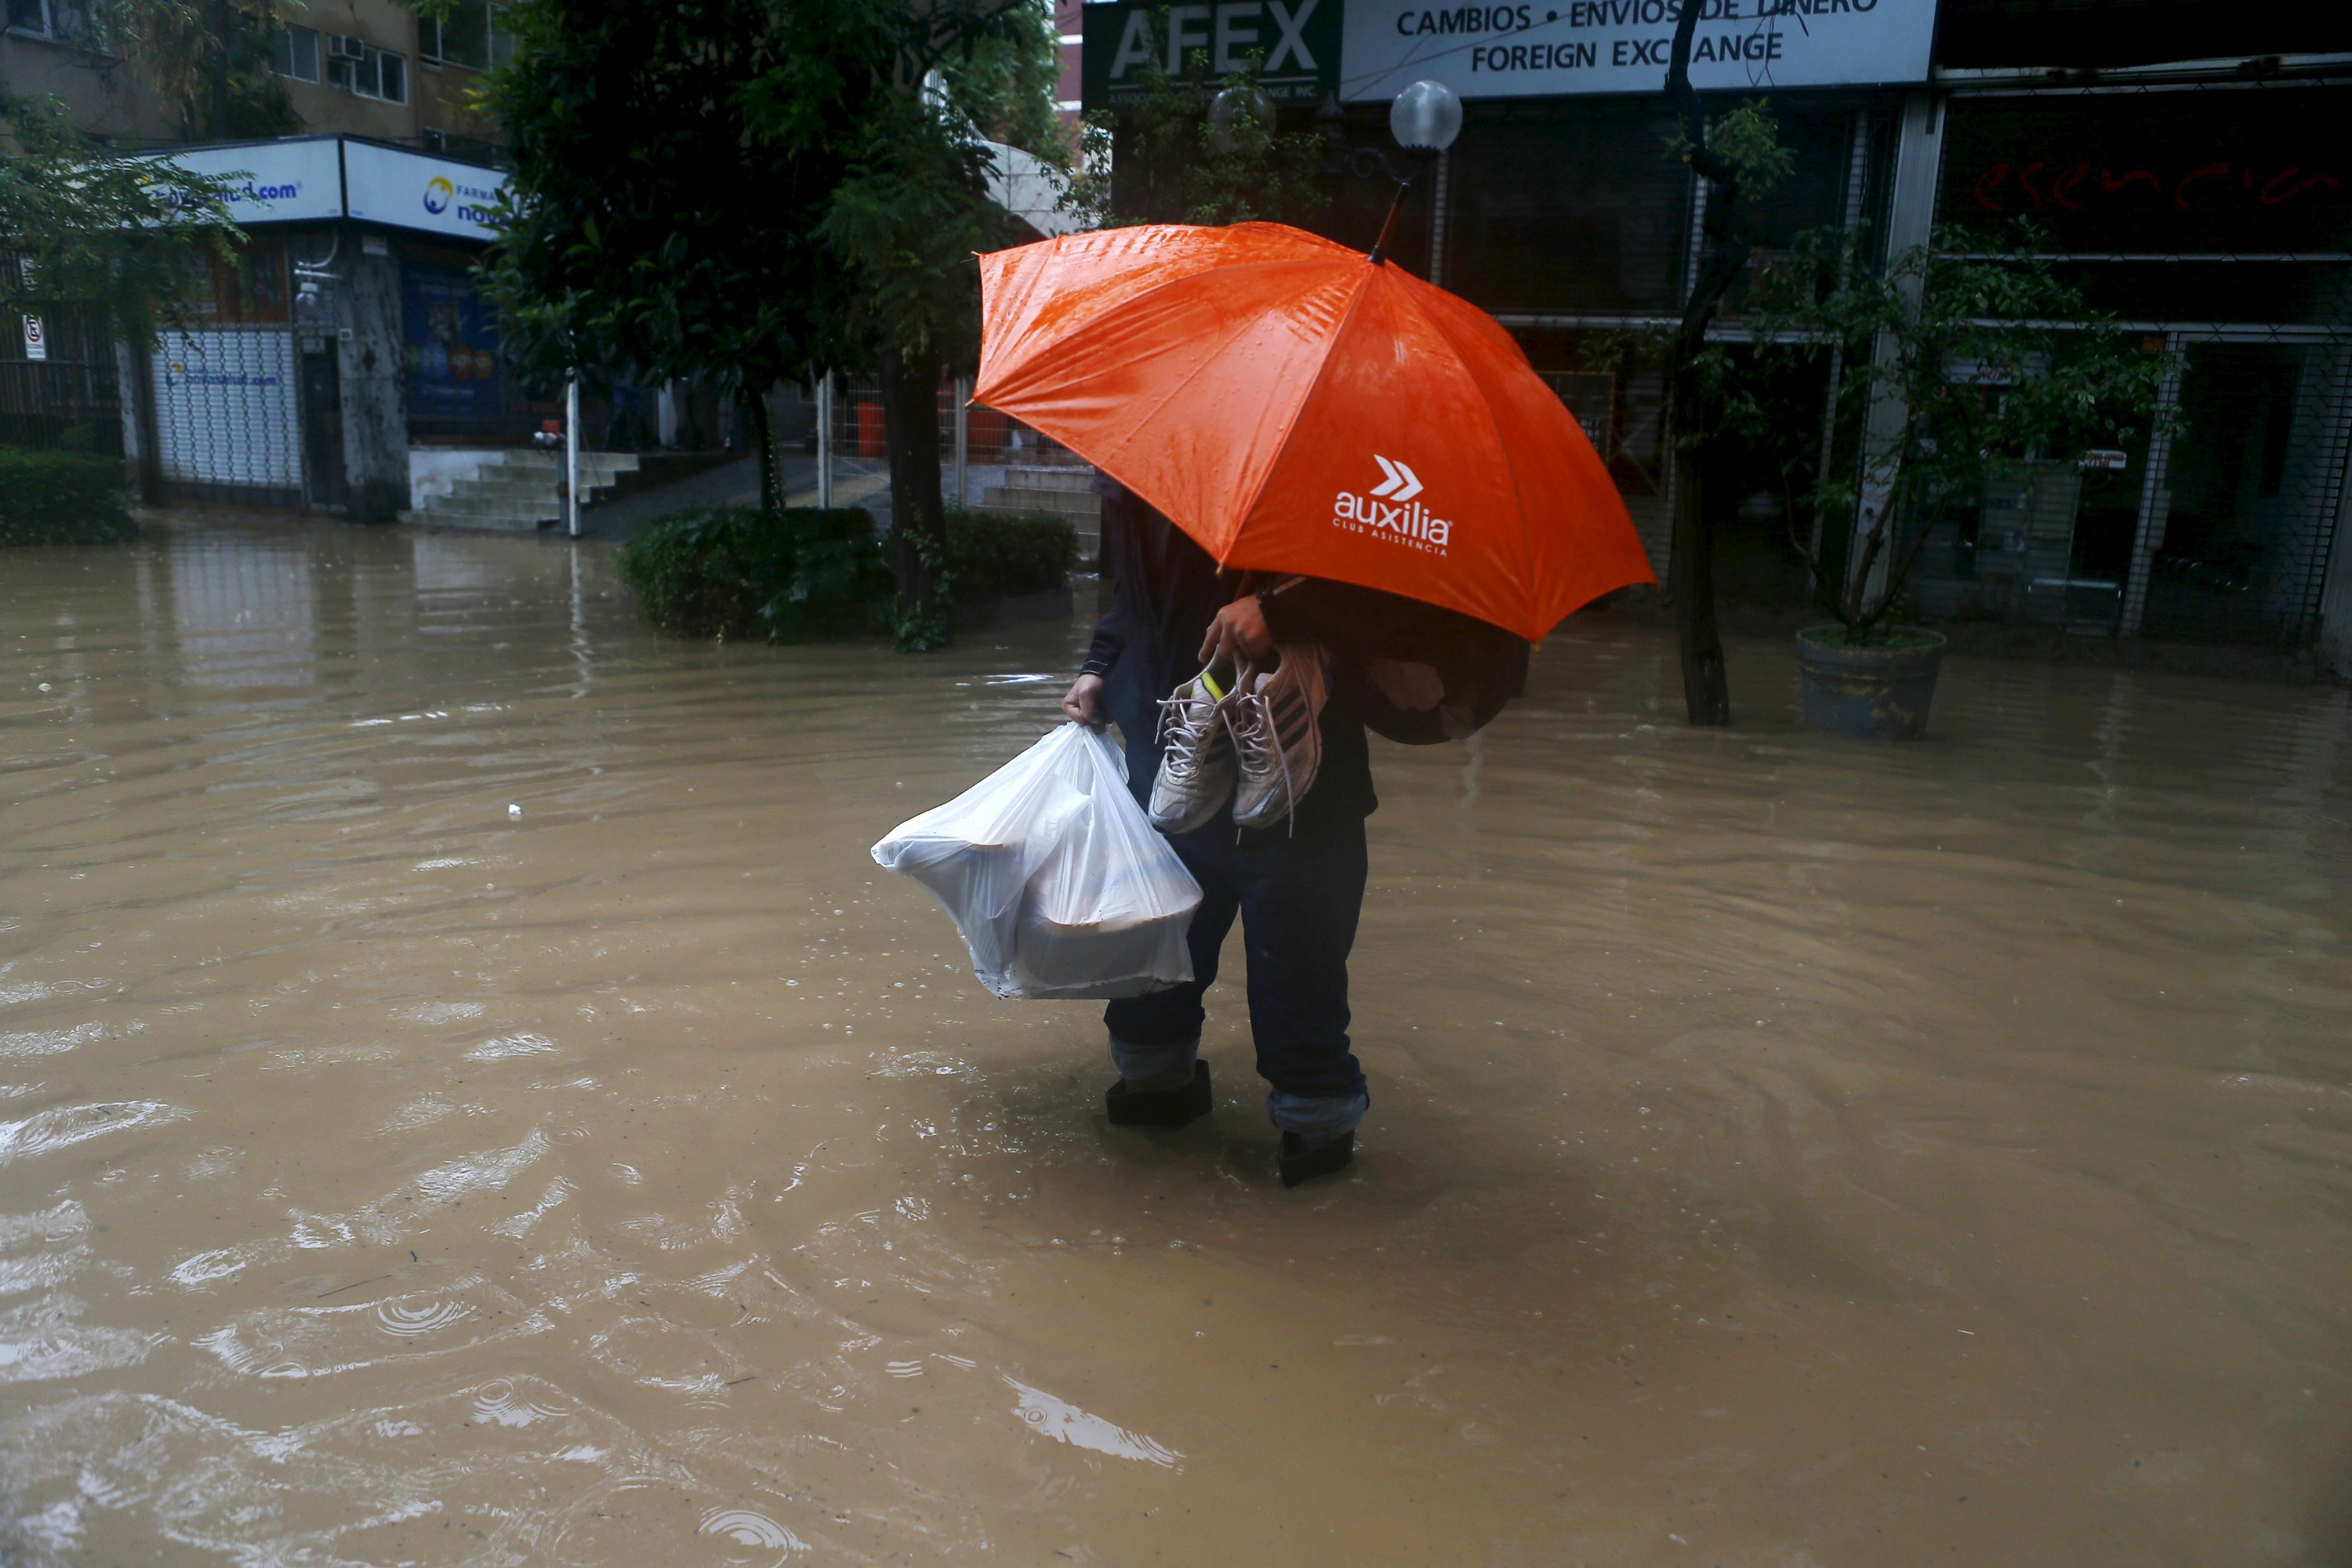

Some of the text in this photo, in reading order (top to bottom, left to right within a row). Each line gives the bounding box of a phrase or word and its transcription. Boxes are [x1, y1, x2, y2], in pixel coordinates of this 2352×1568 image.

[1397, 6, 1531, 35] CAMBIOS
[1570, 0, 1683, 27] ENVIOS
[1700, 0, 1739, 20] DE
[1109, 0, 1319, 79] AFEX
[1472, 33, 1784, 71] FOREIGN EXCANGE
[1108, 91, 1167, 105] ASSOCIA
[1295, 85, 1318, 98] INC.
[1333, 517, 1447, 557] CLUB ASISTENCIA
[1334, 491, 1450, 546] auxilia
